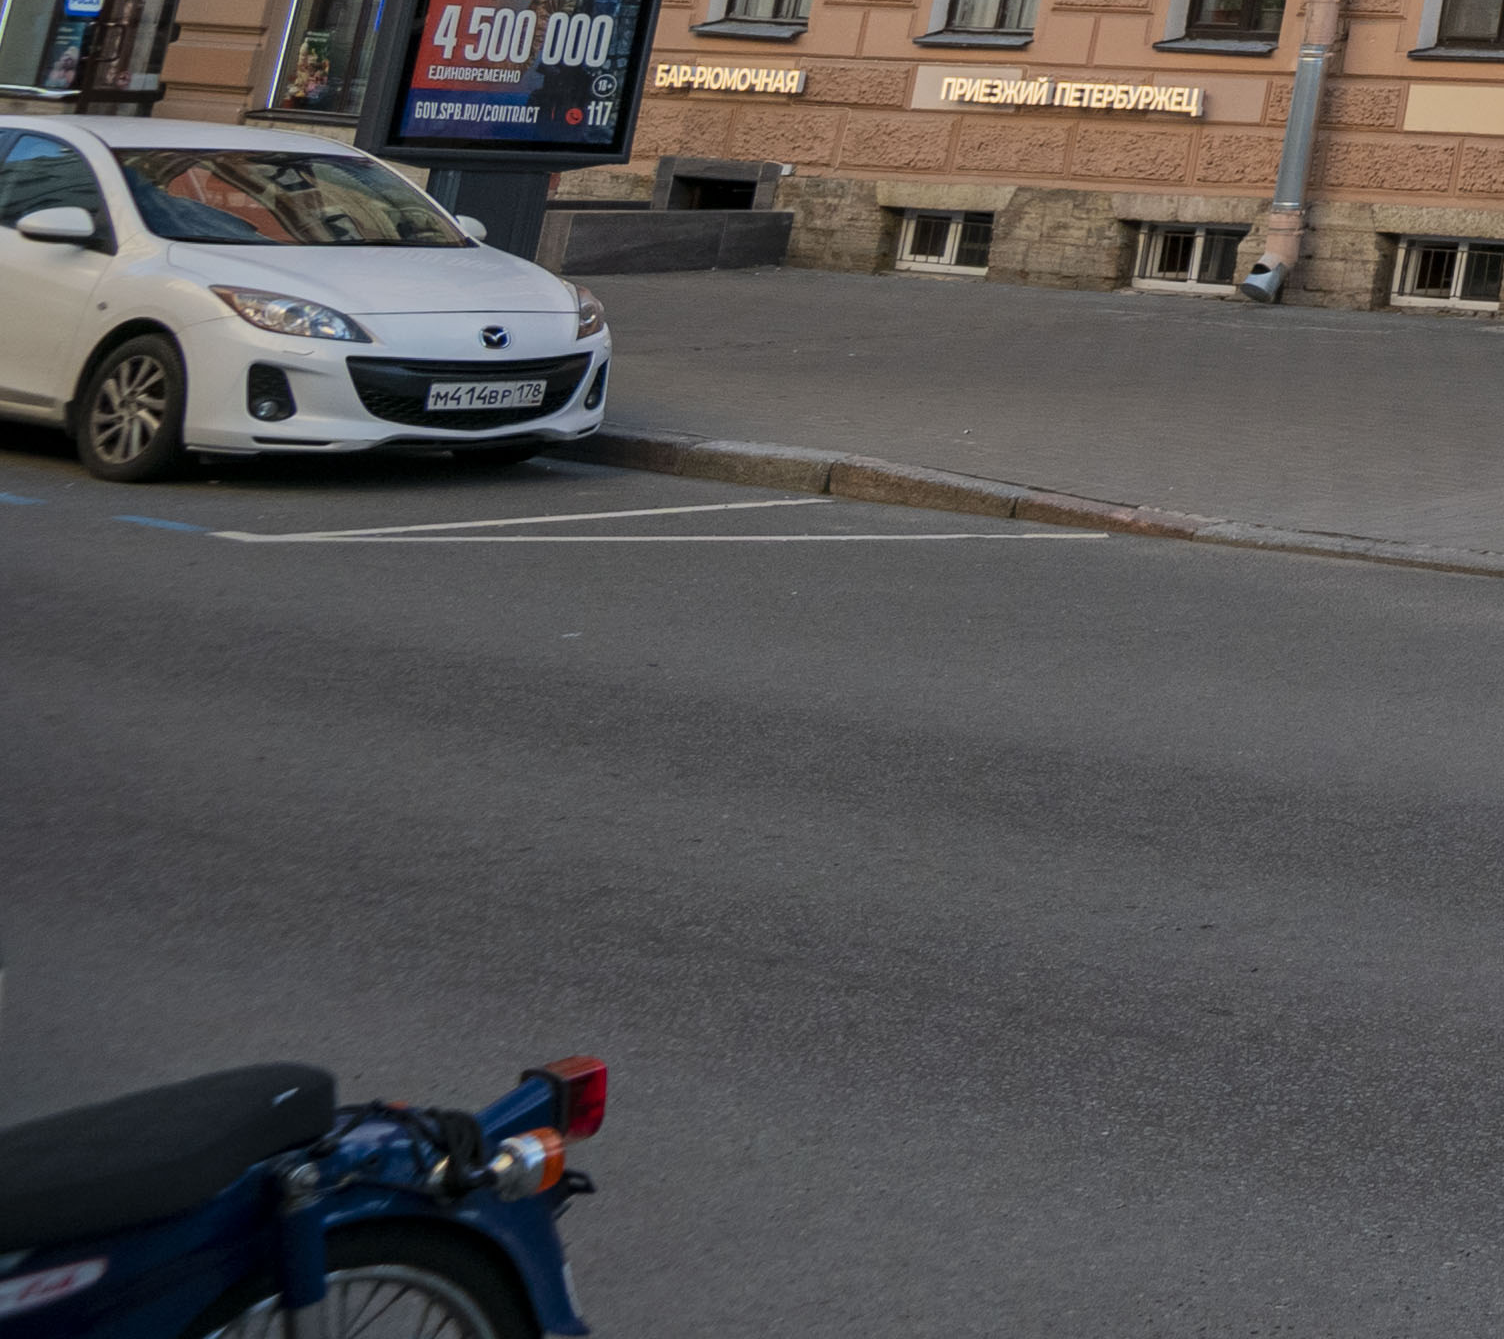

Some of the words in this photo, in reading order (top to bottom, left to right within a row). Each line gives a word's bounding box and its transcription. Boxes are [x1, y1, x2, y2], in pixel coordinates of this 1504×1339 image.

[433, 4, 462, 60] 4
[464, 6, 537, 64] 500
[541, 12, 614, 67] 000
[428, 65, 521, 83] ЕДИНОВРЕМЕННО
[655, 63, 801, 94] БАР-РЮМОЧНАЯ
[941, 76, 1050, 106] ПРИЕЗЖИЙ
[1053, 82, 1201, 117] ПЕТЕРБУРЖЕЦ
[414, 101, 540, 124] GOV.SPB.RU/CONTRACT
[587, 101, 613, 125] 117
[517, 384, 542, 399] 178
